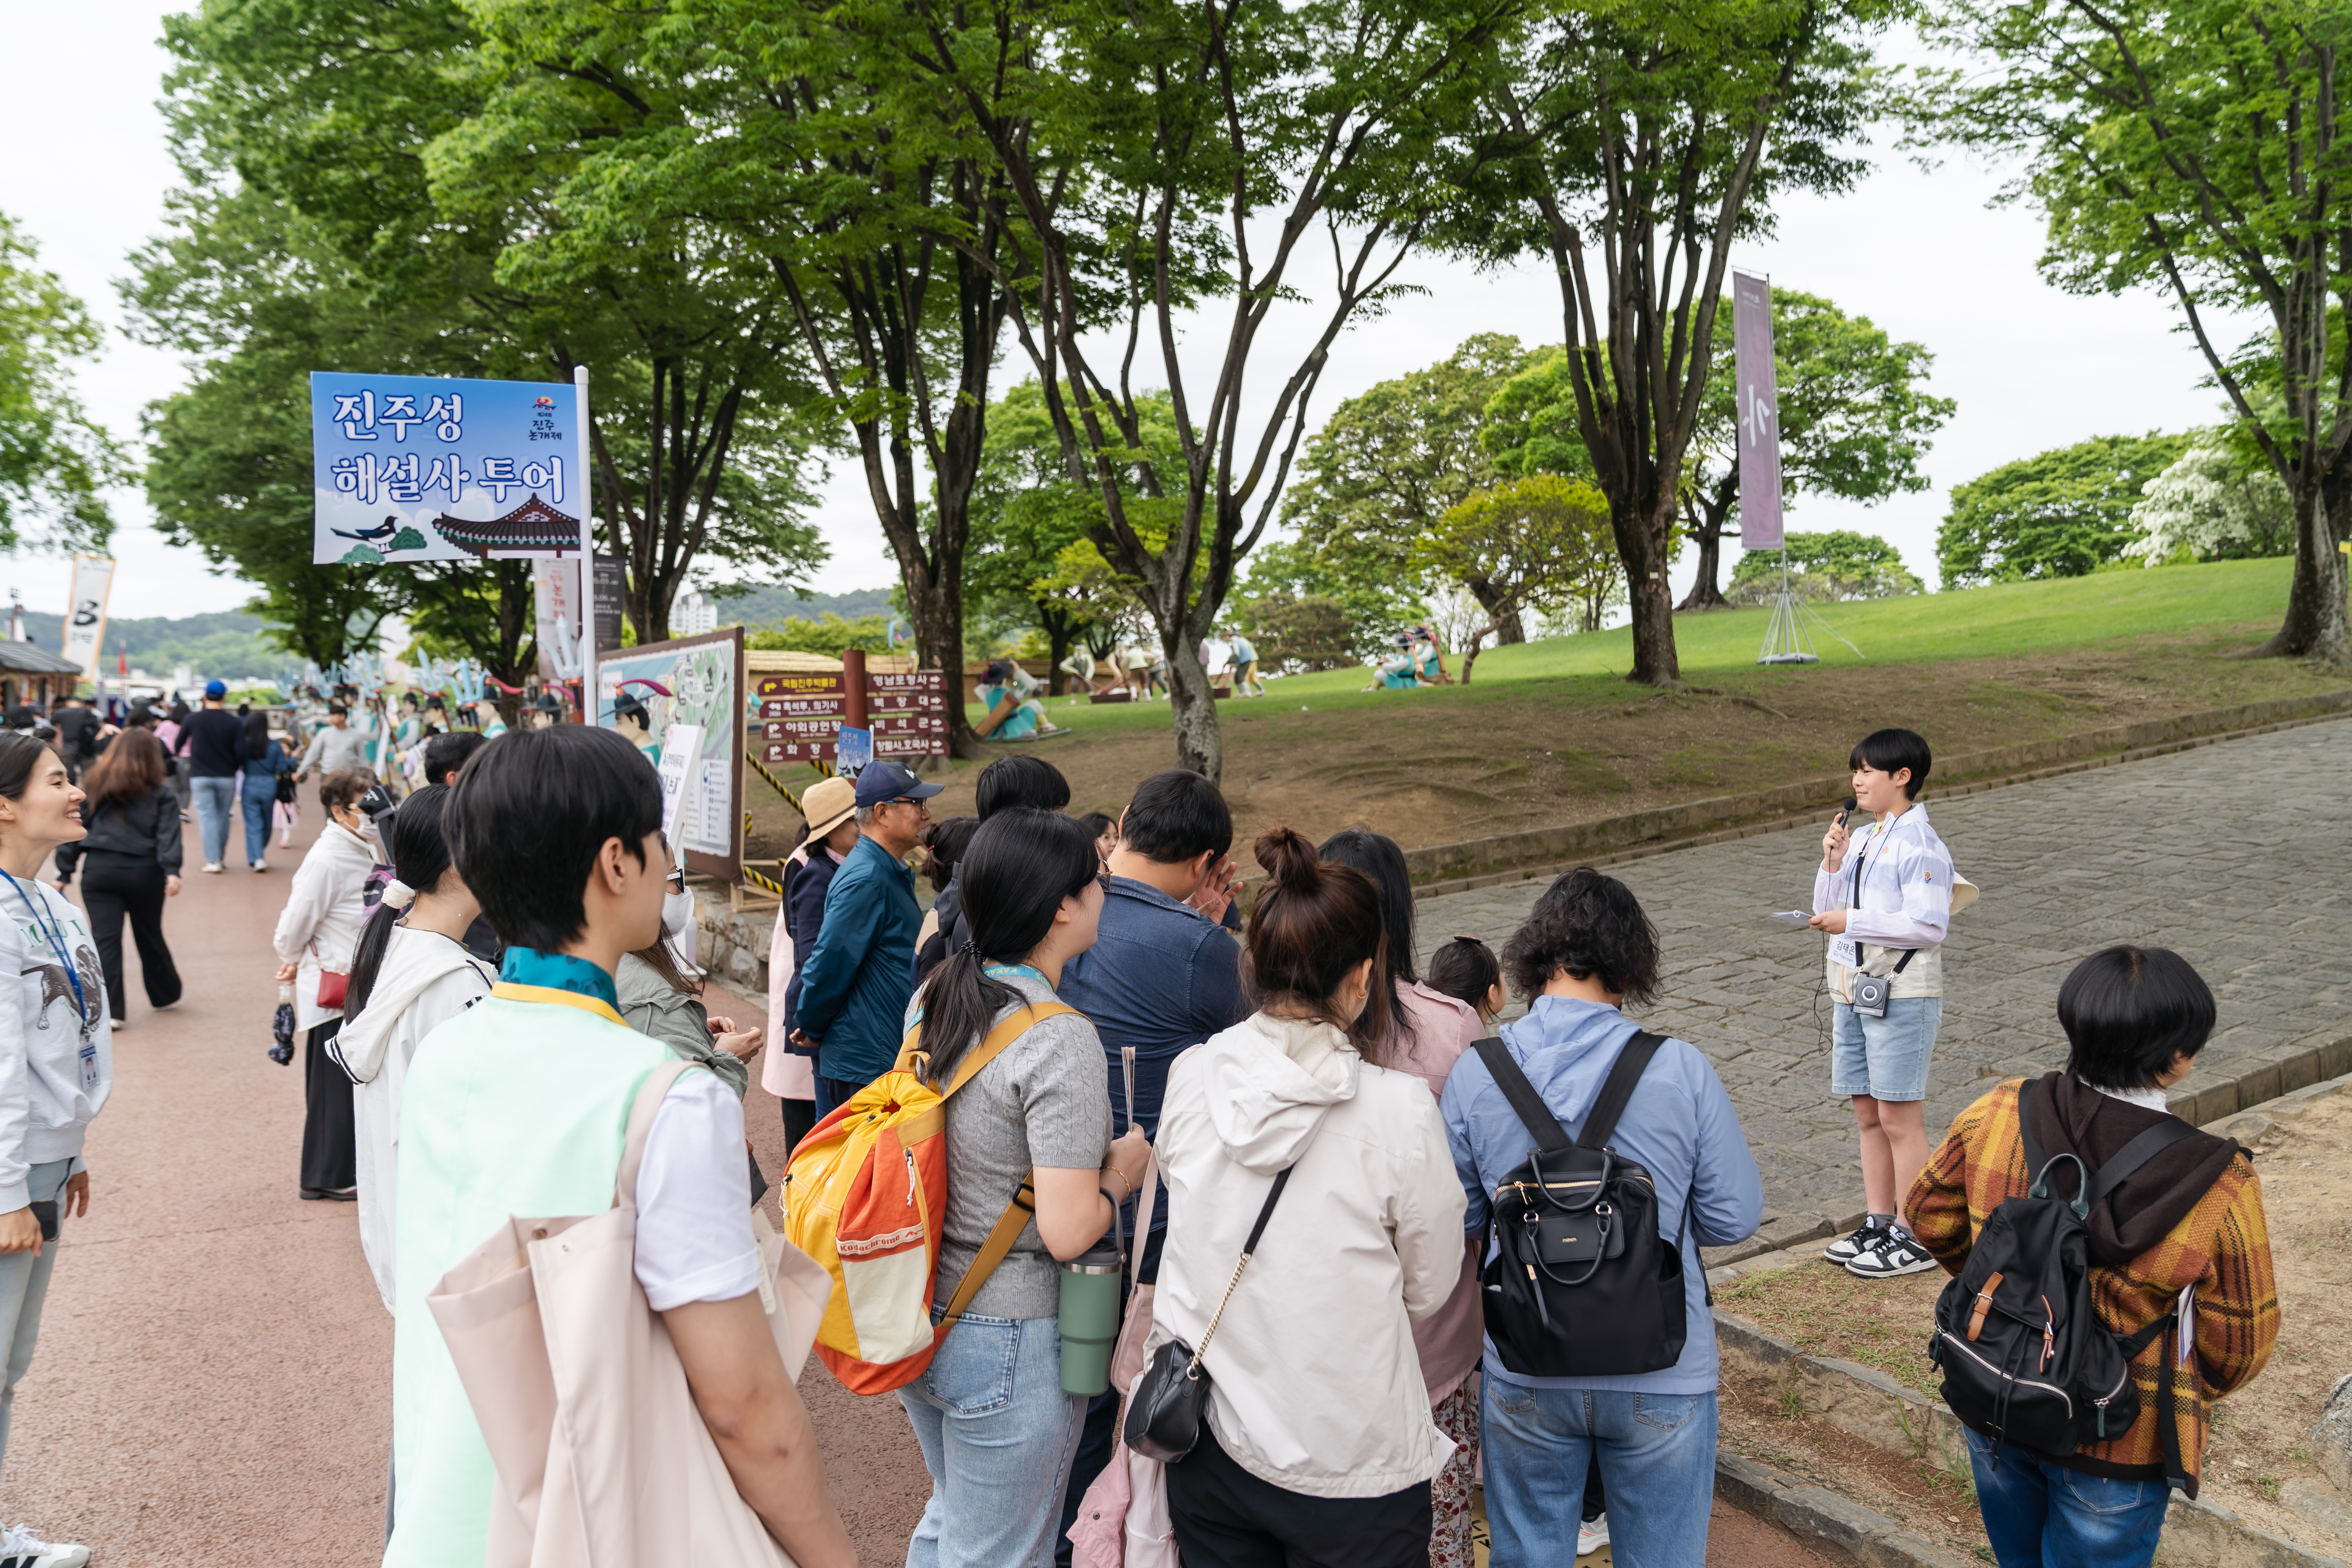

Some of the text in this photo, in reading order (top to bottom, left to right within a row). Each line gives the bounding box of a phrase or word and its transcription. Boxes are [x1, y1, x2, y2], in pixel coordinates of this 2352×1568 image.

[333, 389, 463, 443] 진주성
[533, 420, 554, 431] 진주
[529, 430, 562, 441] 논개제
[331, 453, 564, 505] 해설사 투어
[782, 677, 837, 689] 국립진주박물관
[813, 700, 838, 710] 의기사
[785, 720, 842, 733] 야외공연장
[875, 717, 929, 730] 비석군
[1837, 940, 1855, 956] 김태은
